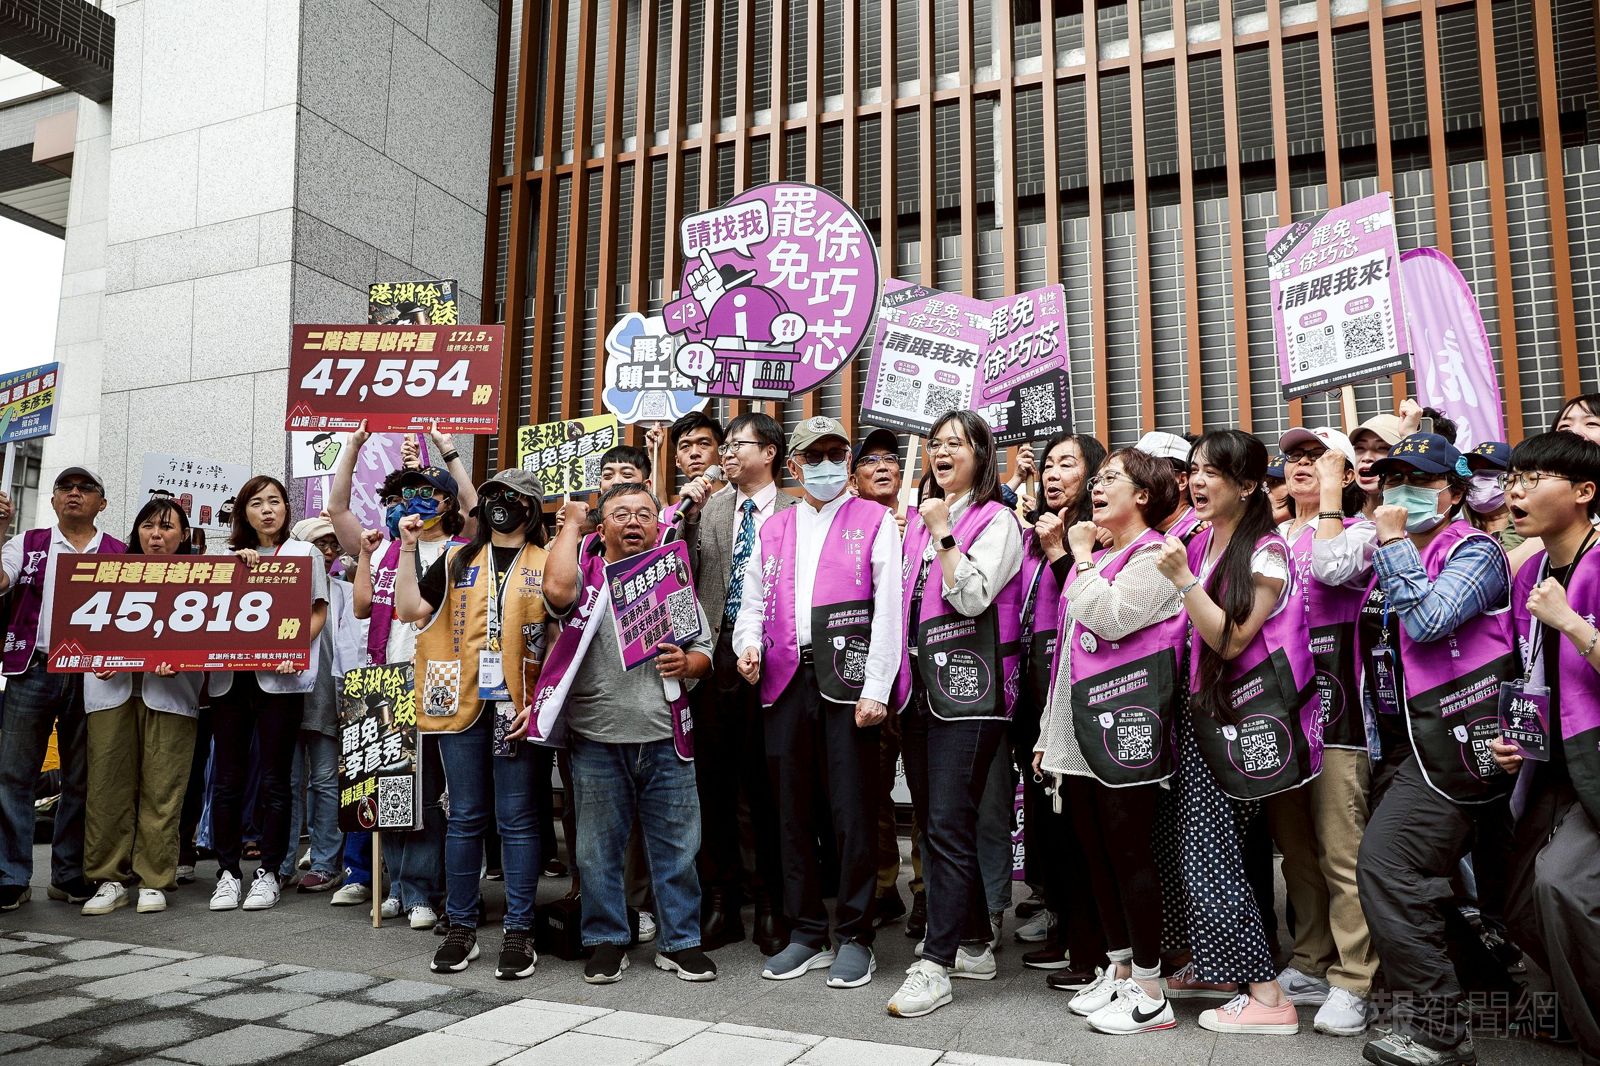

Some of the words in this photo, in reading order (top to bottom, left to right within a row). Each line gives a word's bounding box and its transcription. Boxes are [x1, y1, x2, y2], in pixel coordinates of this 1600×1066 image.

[686, 208, 764, 250] 請找我
[764, 188, 817, 291] 罷免
[1311, 219, 1352, 249] 罷免
[1299, 235, 1360, 275] 徐巧芯
[801, 211, 862, 371] 徐巧芯
[907, 312, 963, 338] 徐巧芯
[923, 299, 961, 320] 罷免
[986, 296, 1035, 346] 罷免
[303, 331, 438, 353] 二階連署收件量
[781, 319, 797, 337] ?!
[687, 350, 704, 370] ?!
[983, 320, 1060, 385] 徐巧芯
[300, 359, 471, 402] 47,554
[471, 384, 493, 405] 份
[20, 390, 53, 414] 李彥秀
[522, 426, 615, 473] 罷免李彥秀
[71, 561, 236, 584] 二階連署送件量
[521, 567, 542, 577] 文山
[525, 577, 543, 587] 退
[623, 550, 677, 605] 罷免李彥秀
[70, 591, 274, 638] 45,818
[277, 618, 300, 640] 份
[342, 716, 379, 756] 罷免
[344, 732, 403, 781] 李彥秀
